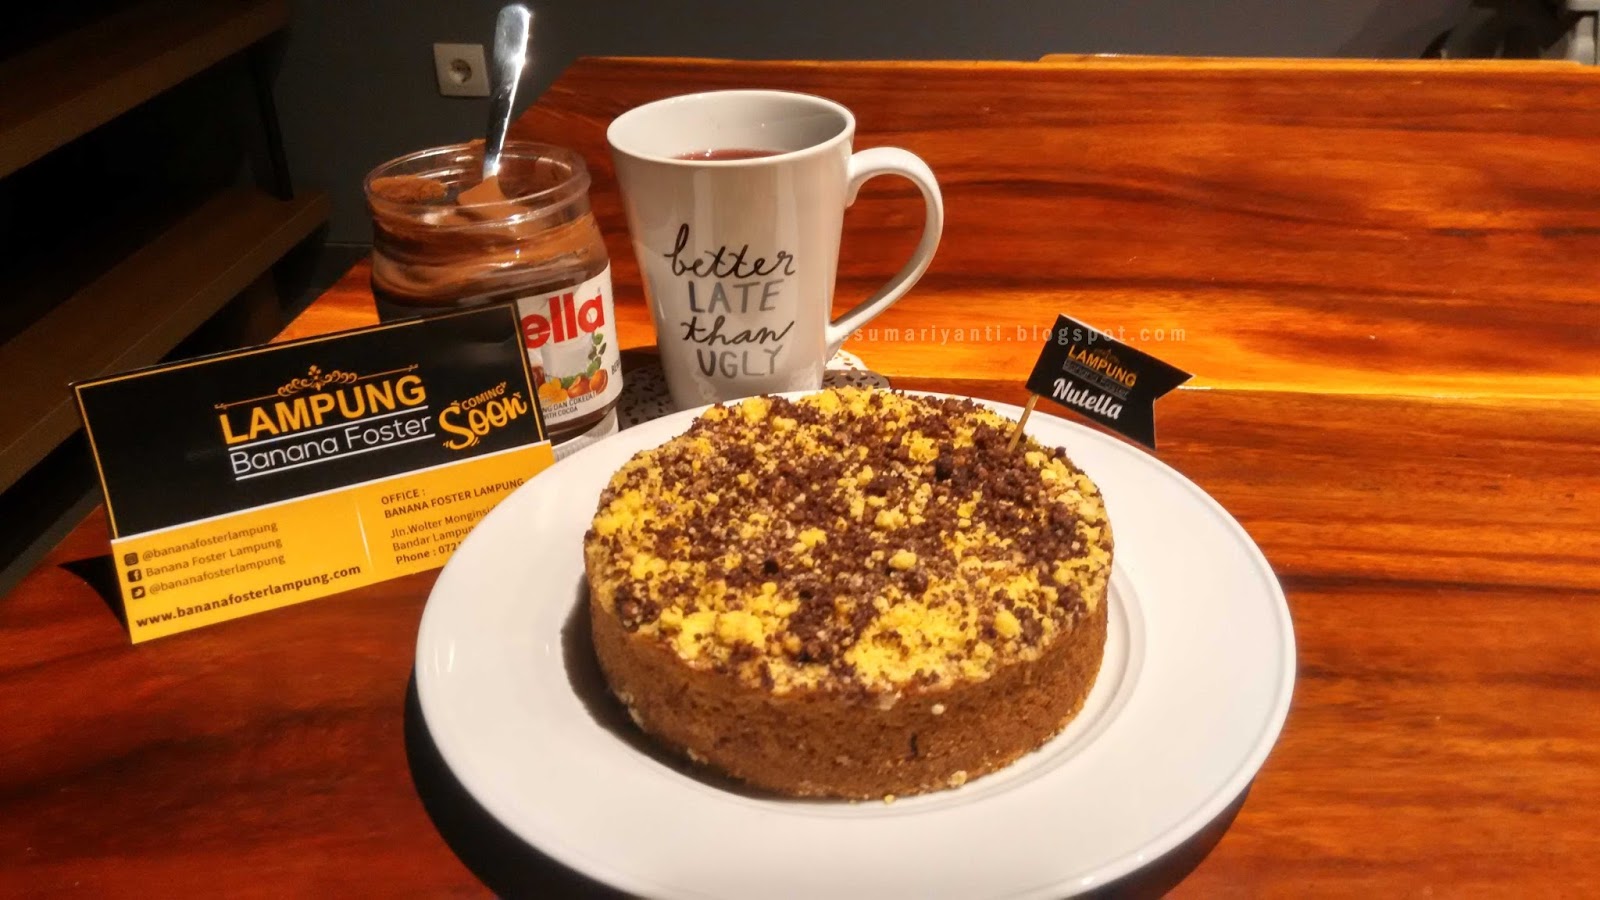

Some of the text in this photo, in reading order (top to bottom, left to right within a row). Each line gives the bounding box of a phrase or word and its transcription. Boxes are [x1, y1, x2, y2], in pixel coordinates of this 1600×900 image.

[663, 223, 796, 278] better
[687, 279, 785, 314] LATE
[680, 315, 795, 346] than
[696, 344, 784, 379] UGLY
[1068, 344, 1137, 388] LAMPUNG
[218, 374, 427, 445] LAMPUNG
[460, 384, 505, 411] COMING
[1052, 378, 1123, 420] Nutella
[438, 396, 528, 450] Soon
[229, 415, 432, 474] Banana Foster
[381, 488, 419, 505] OFFICE
[384, 478, 525, 519] BANANA FOSTER LAMPUNG
[142, 521, 278, 562] @bananafosterlampung
[390, 518, 442, 539] Jln.Wolter
[392, 525, 475, 552] Bandar Lampun
[145, 537, 283, 577] Banana Foster Lampung
[149, 553, 286, 595] @bananafosterlampung
[395, 550, 430, 565] Phone
[135, 564, 362, 628] www.bananafosterlampung.com
